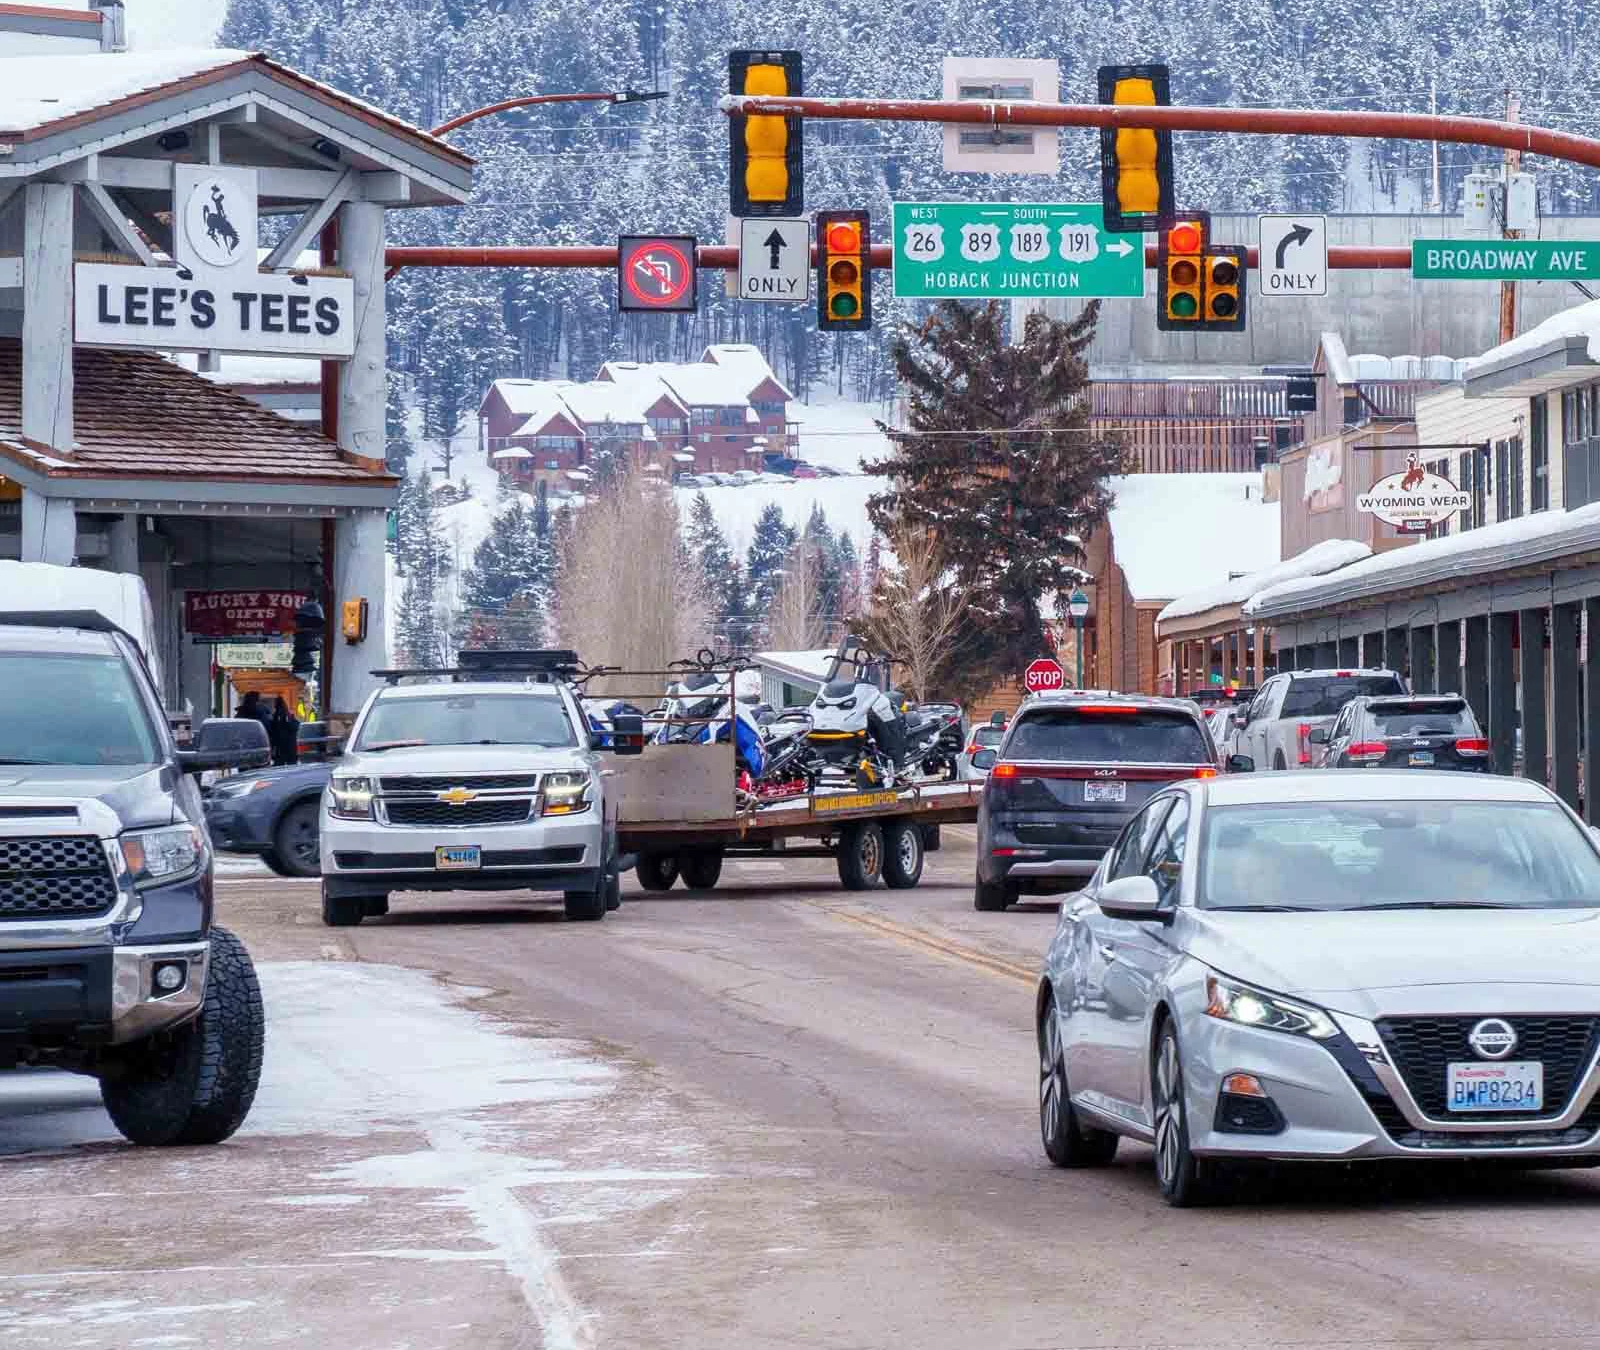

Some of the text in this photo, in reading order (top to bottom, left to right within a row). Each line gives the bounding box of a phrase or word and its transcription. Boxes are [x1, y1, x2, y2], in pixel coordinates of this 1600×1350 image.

[911, 208, 938, 219] WEST
[1014, 208, 1048, 219] SOUTH
[912, 232, 1090, 252] 26 89 189 191
[1427, 250, 1588, 271] BROADWAY AVE
[748, 277, 800, 293] ONLY
[924, 272, 1080, 289] HOBACK JUNCTION
[1270, 273, 1318, 289] ONLY
[97, 283, 340, 336] LEE'S TEES
[1360, 495, 1468, 508] WYOMING WEAR
[192, 594, 306, 611] LUCKY YOU
[226, 609, 276, 619] GIFTS
[227, 651, 264, 661] PHOTO
[1028, 670, 1062, 687] STOP
[1413, 738, 1430, 747] Jeep
[1475, 1034, 1513, 1043] NISSAN
